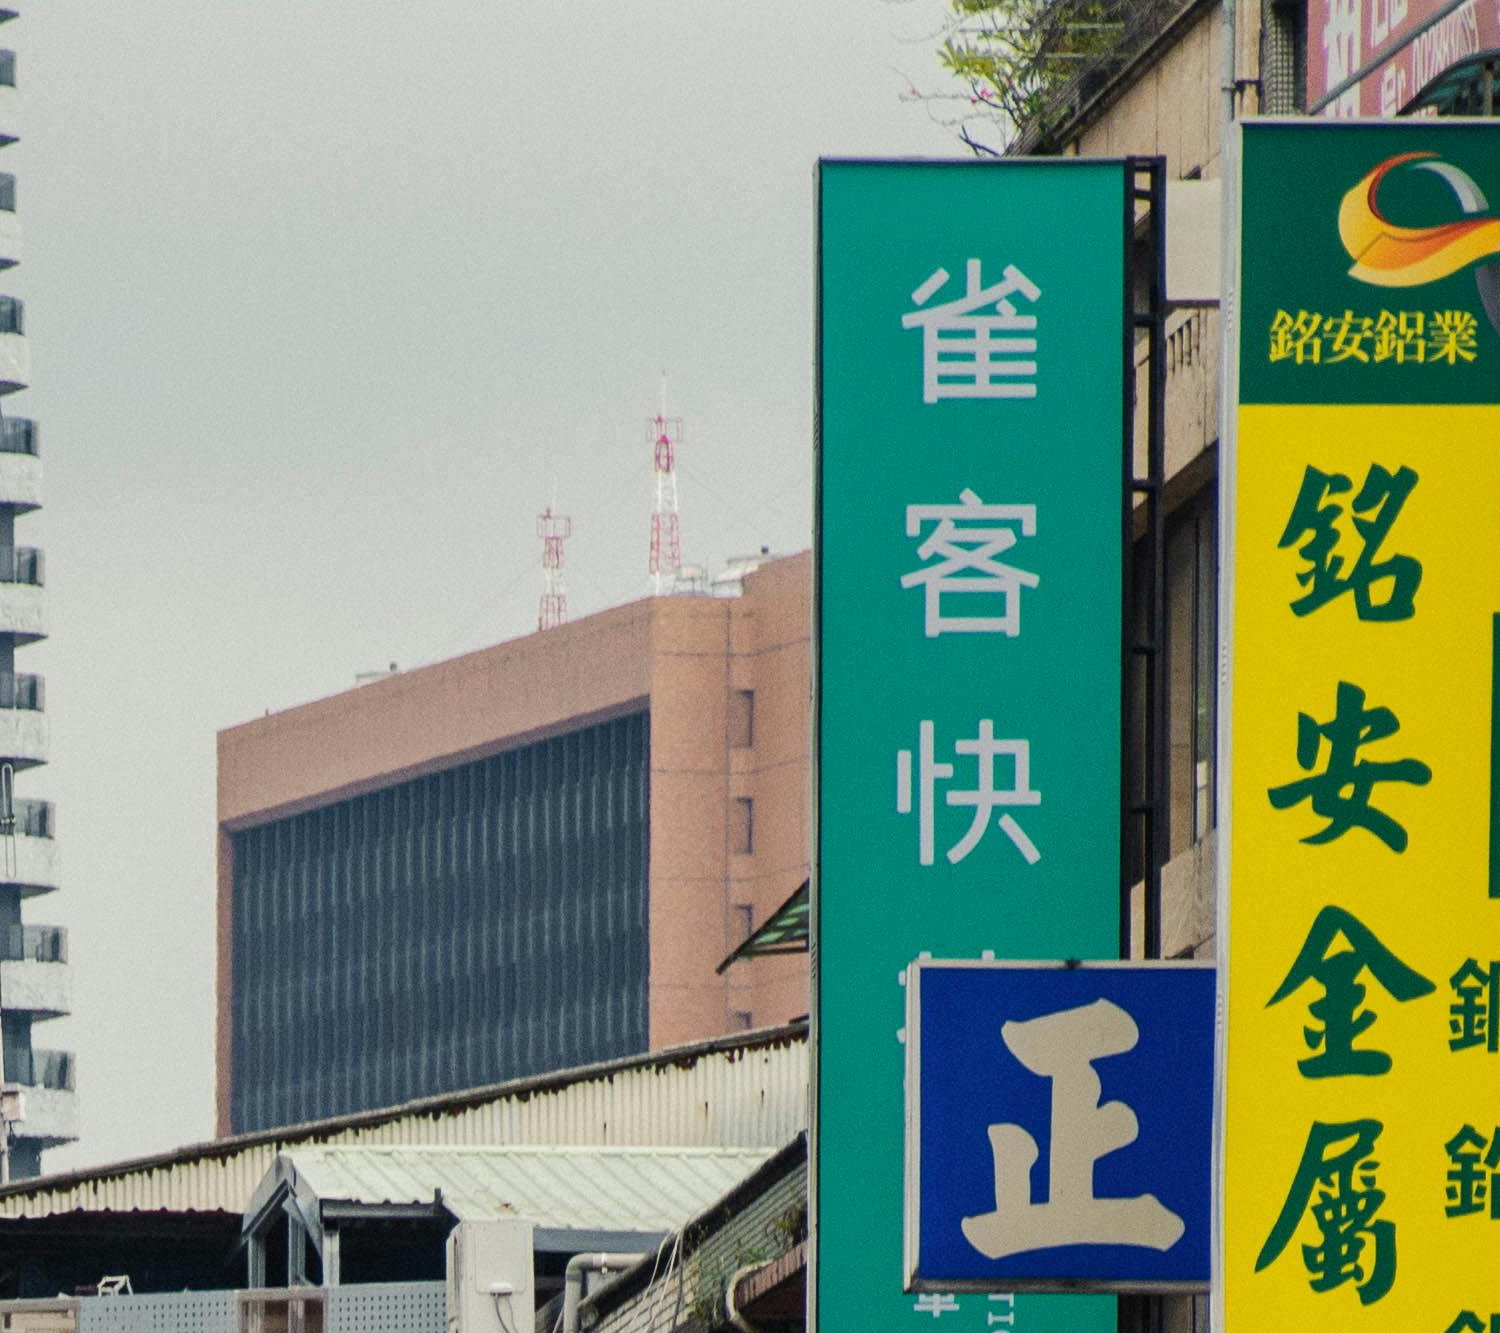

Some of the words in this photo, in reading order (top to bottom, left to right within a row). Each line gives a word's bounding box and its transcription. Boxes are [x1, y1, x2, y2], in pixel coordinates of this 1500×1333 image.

[1268, 309, 1480, 366] 銘安鋁業
[896, 258, 1042, 870] 雀客快
